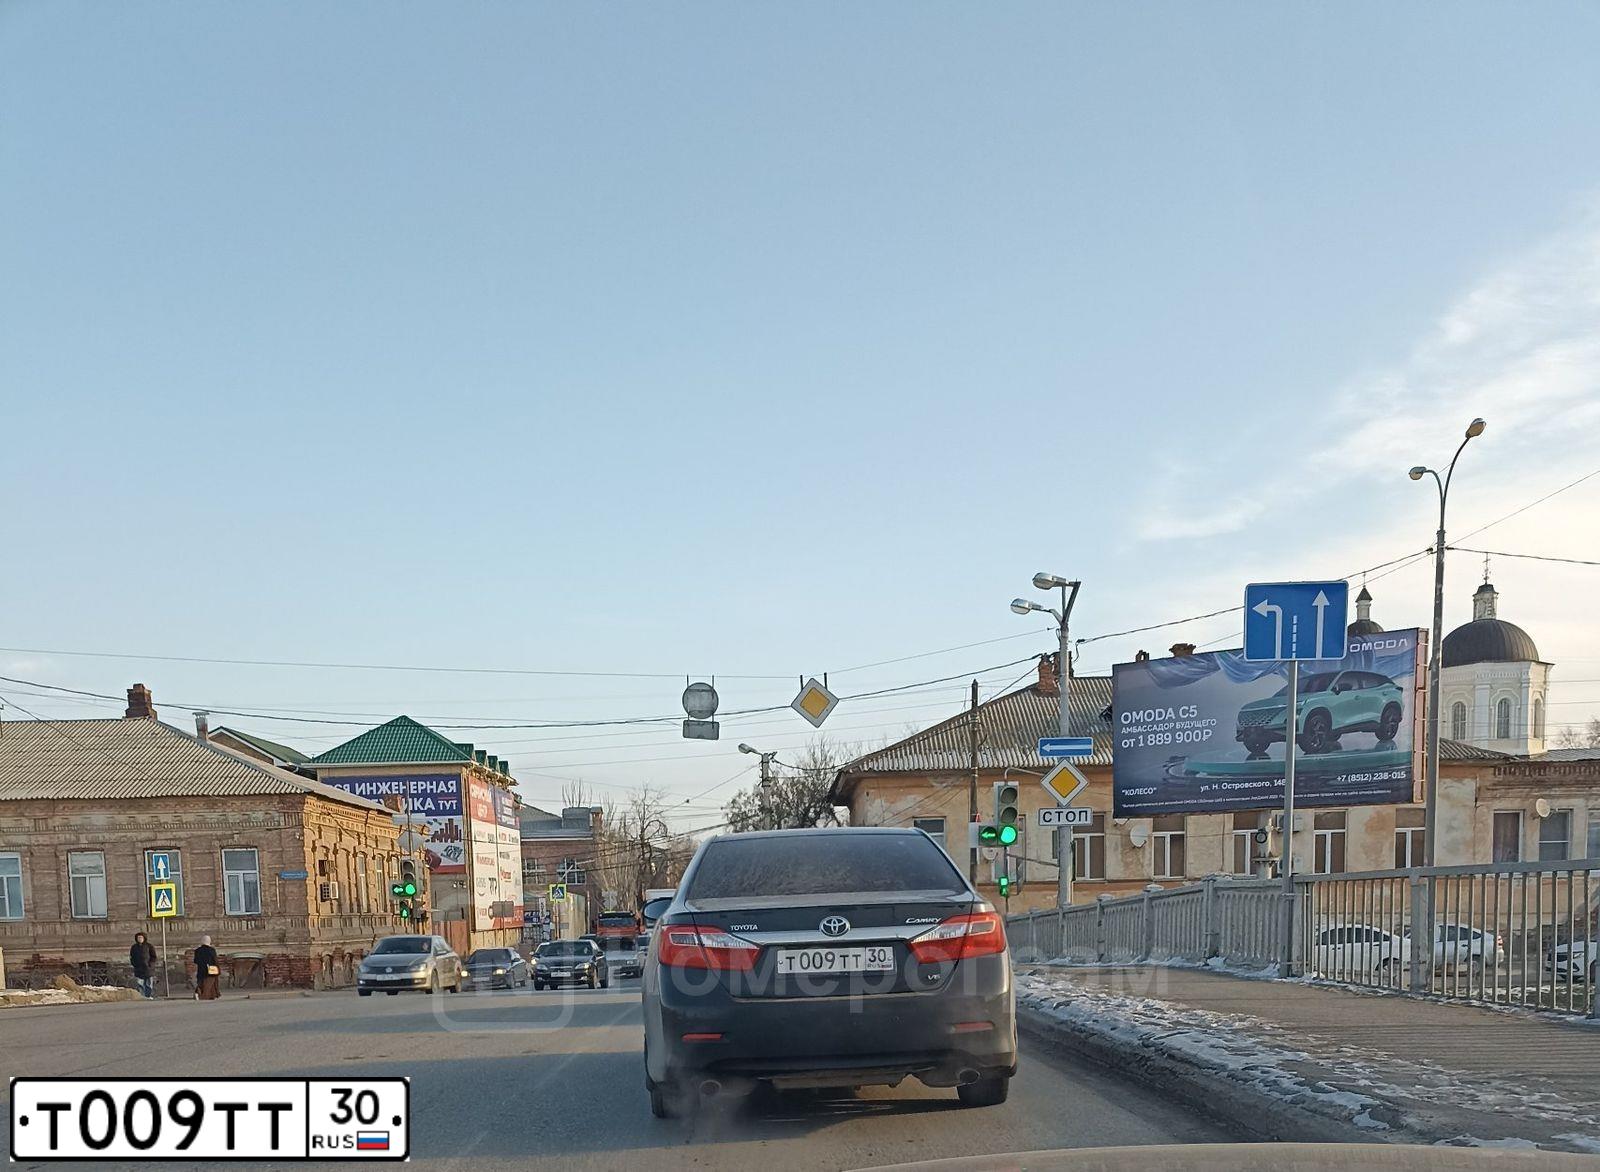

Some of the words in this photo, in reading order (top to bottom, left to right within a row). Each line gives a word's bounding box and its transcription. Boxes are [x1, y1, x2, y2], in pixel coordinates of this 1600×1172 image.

[1121, 707, 1176, 724] OMODA
[1179, 705, 1198, 718] C5
[1121, 722, 1175, 734] АМБАССАДОР
[1175, 718, 1217, 729] БУДУЩЕГО
[1147, 732, 1172, 746] 889
[1348, 773, 1372, 783] (8512)
[355, 780, 457, 795] ИНЖЕНЕРНАЯ
[1121, 786, 1158, 797] "КОЛЕСО"
[1200, 784, 1211, 793] ул.
[438, 800, 457, 811] ТУТ
[1042, 810, 1088, 823] СТОП
[730, 923, 758, 931] TOYOTA
[868, 948, 887, 963] 30
